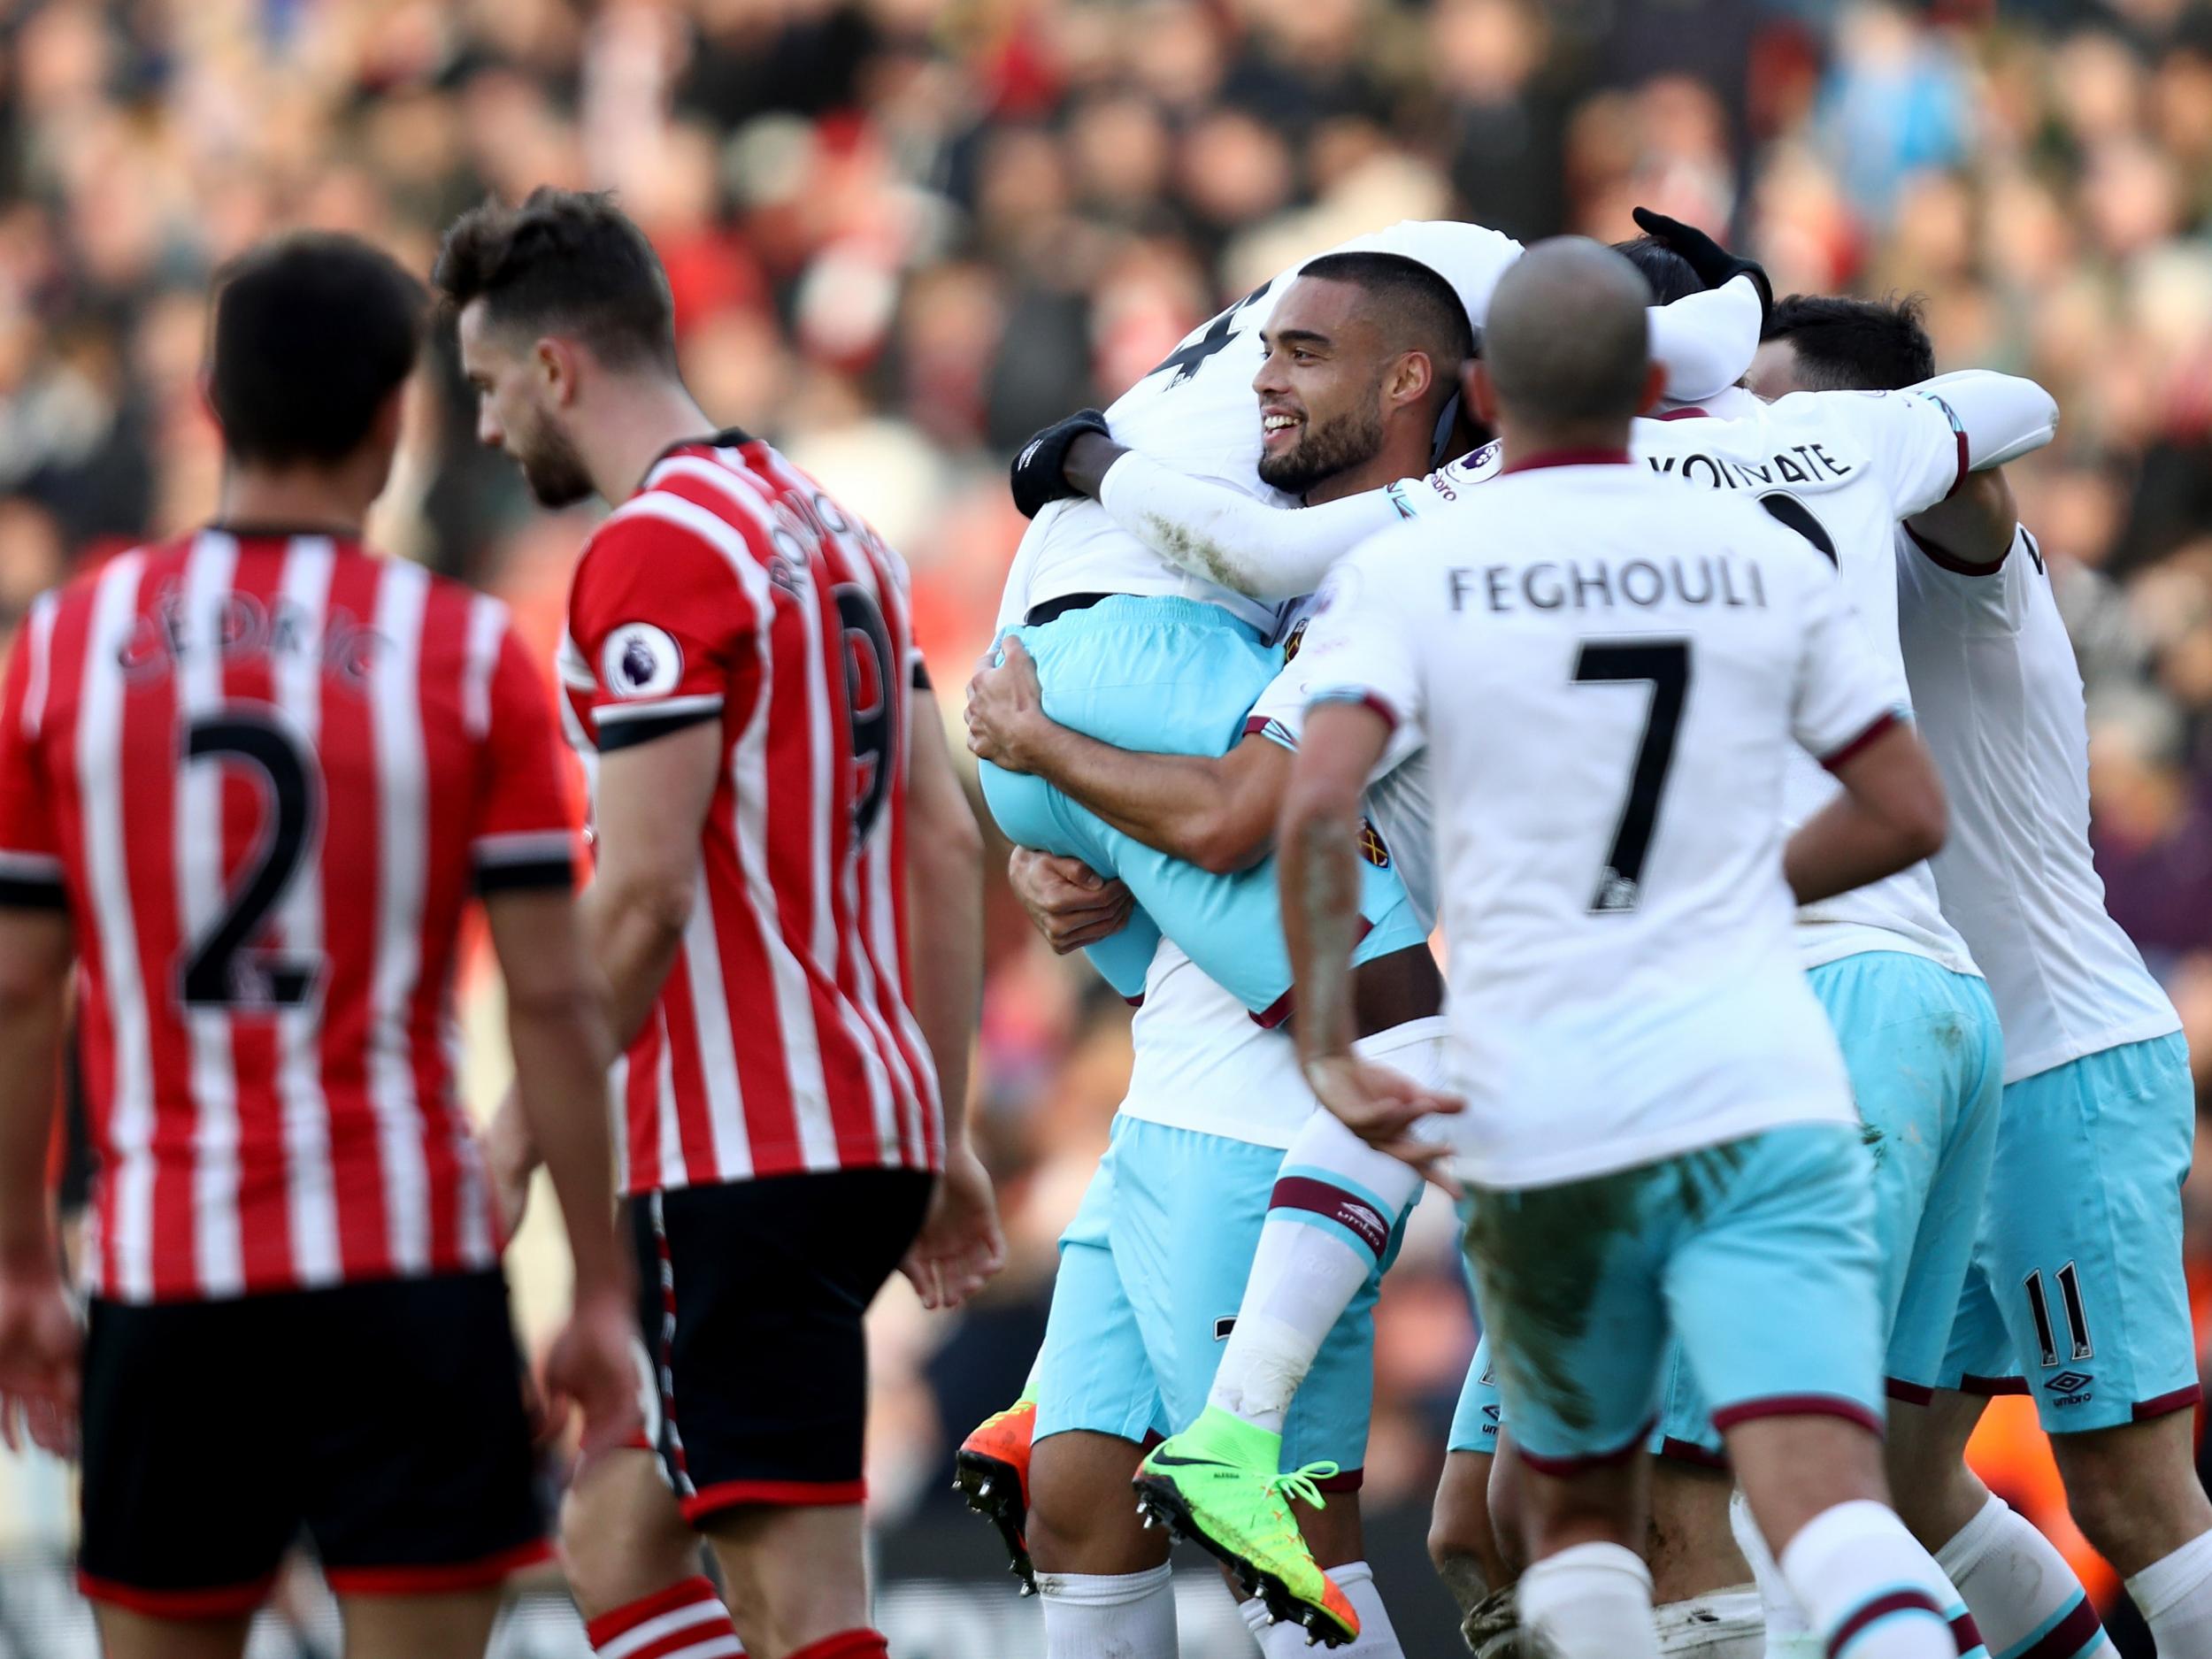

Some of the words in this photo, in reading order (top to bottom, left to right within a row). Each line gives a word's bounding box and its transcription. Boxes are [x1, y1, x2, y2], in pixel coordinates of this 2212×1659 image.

[1448, 554, 1769, 612] FEGHOULI
[833, 580, 901, 854] 9
[1570, 634, 1695, 913] 7
[177, 705, 327, 1007] 2
[1337, 1210, 1380, 1247] umbro
[2024, 1260, 2093, 1367] 11
[2053, 1392, 2093, 1408] umbro
